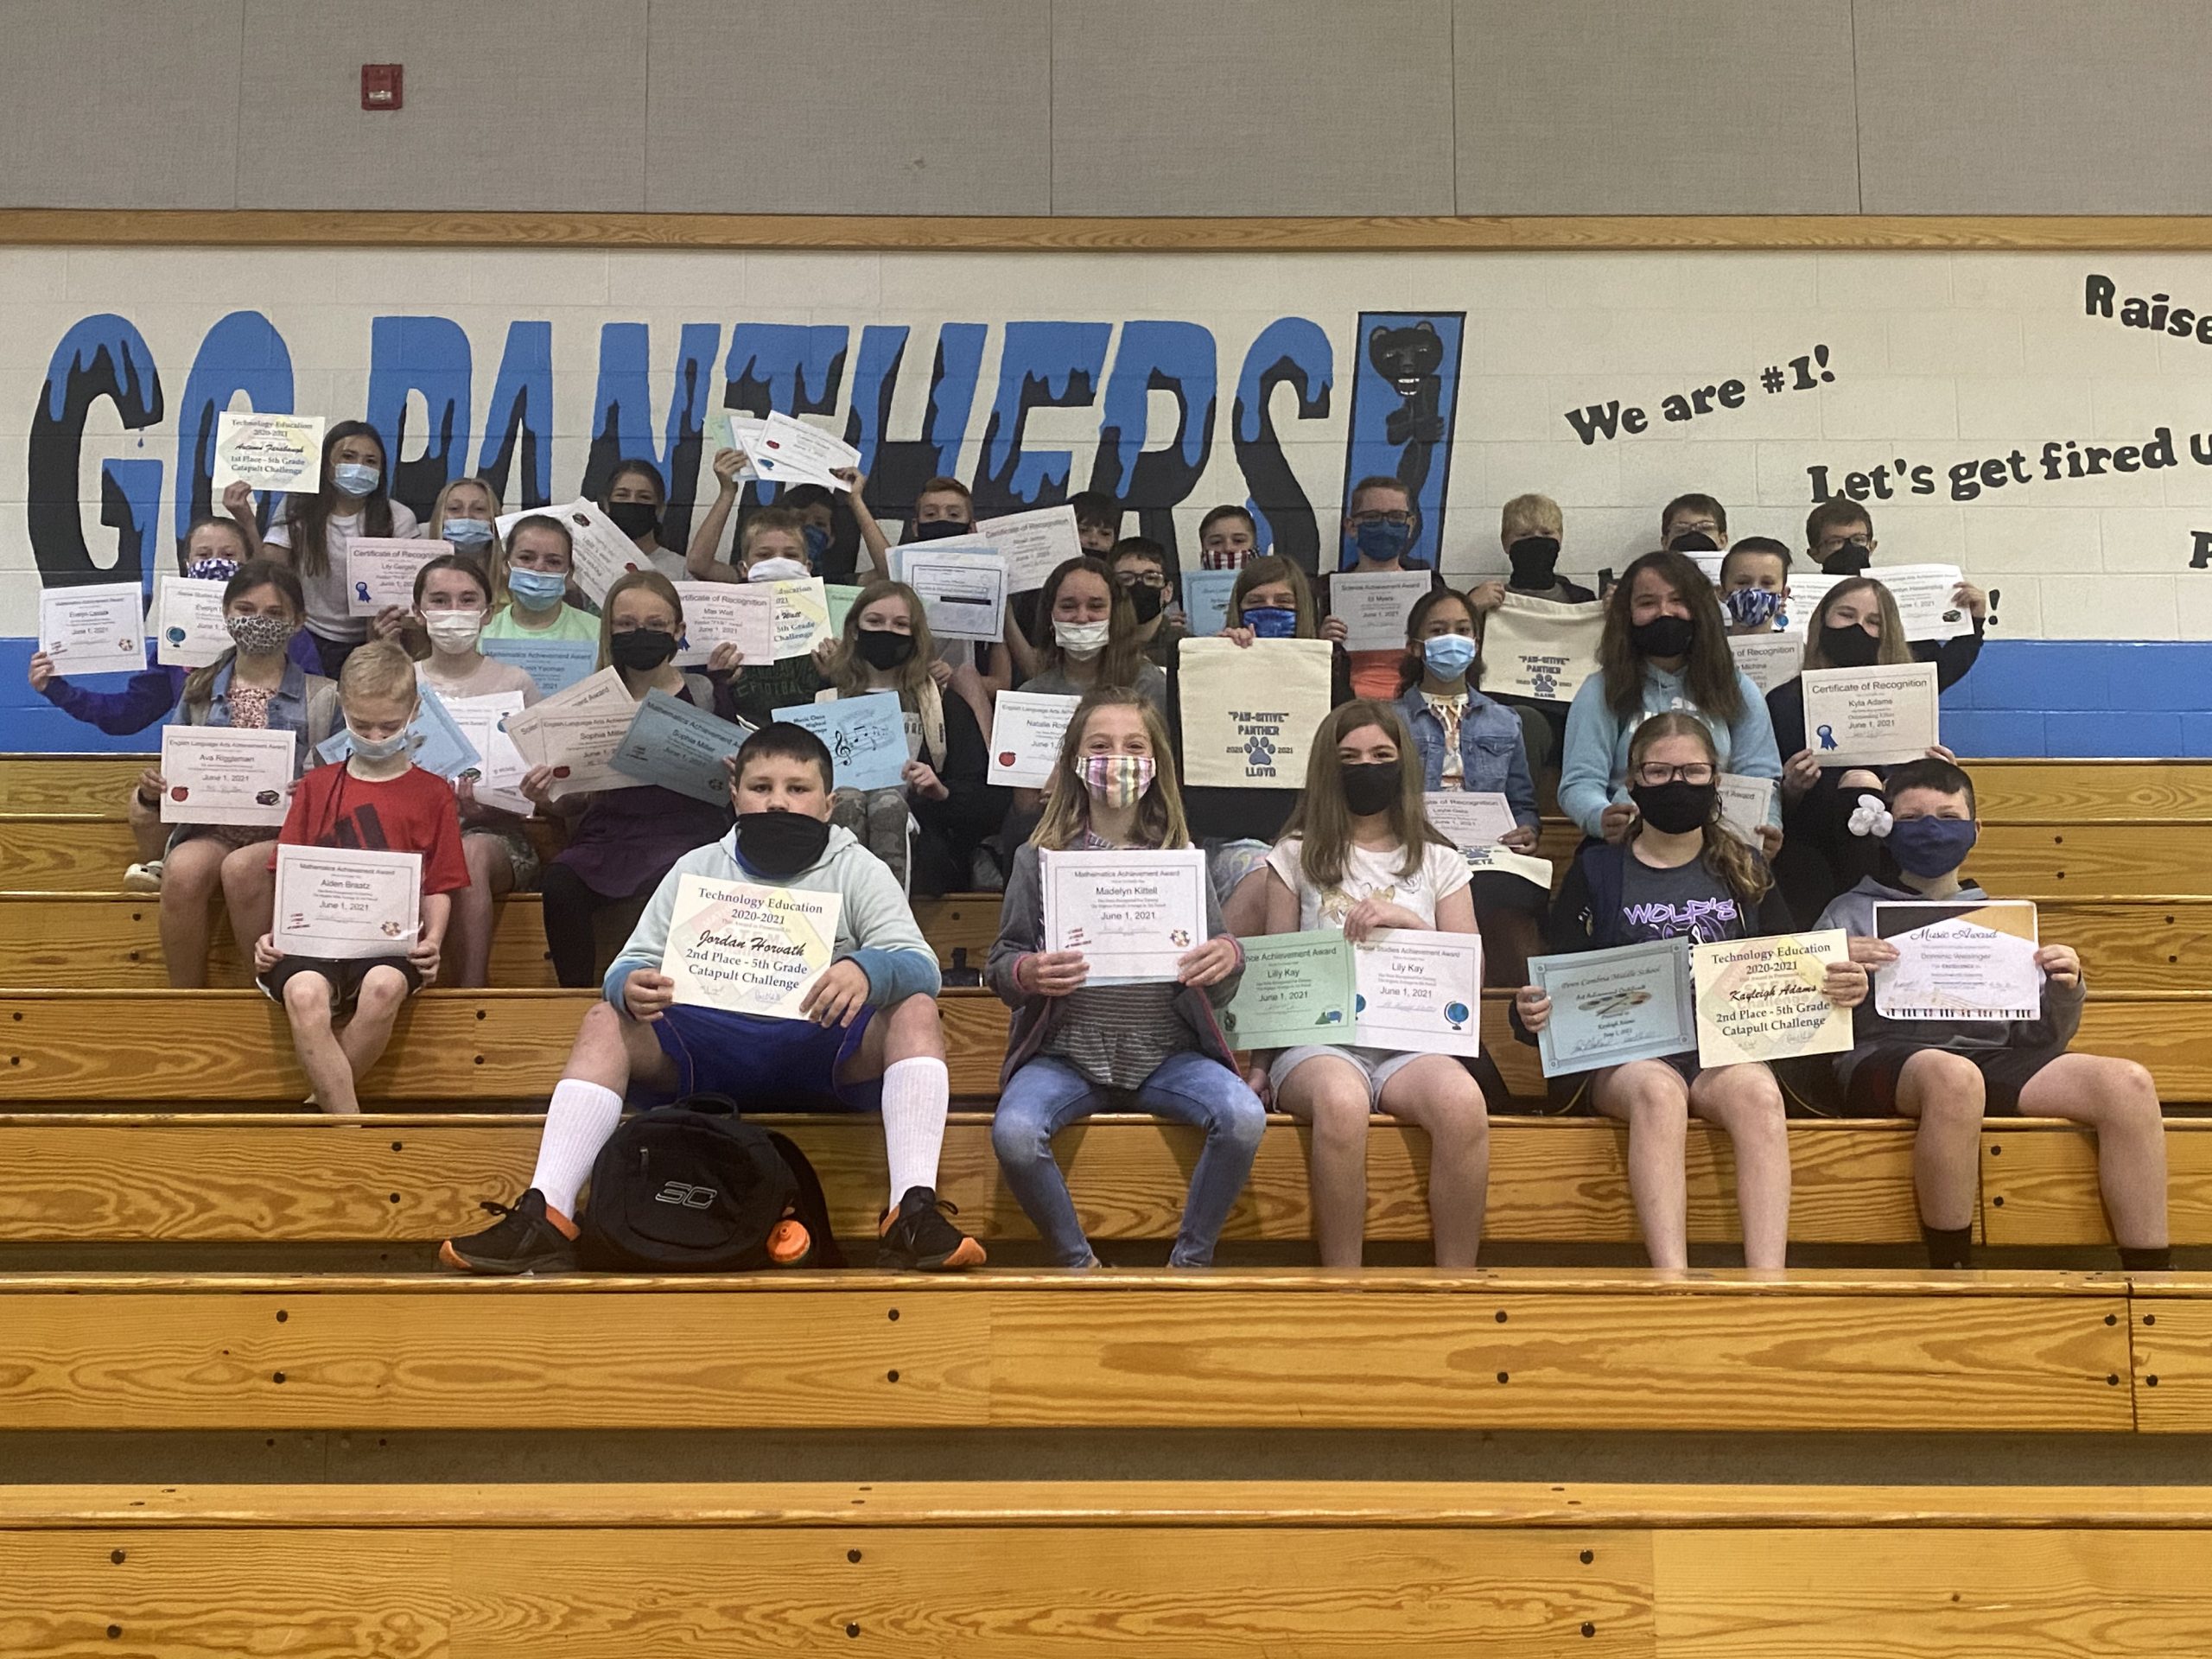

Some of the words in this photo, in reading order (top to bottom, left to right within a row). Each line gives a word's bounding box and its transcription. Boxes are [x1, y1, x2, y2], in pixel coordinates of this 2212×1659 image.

[2086, 274, 2212, 345] Raise
[1565, 400, 1648, 445] We
[1662, 379, 1745, 422] are
[1760, 344, 1835, 393] #1!
[28, 311, 294, 618] GO
[264, 466, 302, 475] Challenge
[1808, 458, 1935, 503] Let's
[1948, 449, 2031, 501] get
[2040, 427, 2177, 480] fired
[721, 595, 767, 607] Recognition
[774, 632, 813, 642] Challenge
[1747, 646, 1795, 656] Recognition
[1812, 684, 1858, 694] Certificate
[1872, 679, 1927, 690] Recognition
[647, 702, 689, 725] Mathematics
[690, 721, 732, 746] Achievement
[1238, 725, 1280, 735] PANTHER
[1246, 766, 1276, 777] LLOYD
[300, 863, 335, 872] Mathematics
[337, 866, 374, 874] Achievement
[321, 879, 343, 888] Aiden
[1096, 887, 1132, 896] Madelyn
[1135, 887, 1158, 895] Kittell
[319, 900, 339, 909] June
[349, 902, 369, 911] 2021
[698, 887, 765, 909] Technology
[767, 898, 823, 913] Education
[731, 908, 785, 925] 2020-2021
[1910, 927, 1949, 941] Music
[1952, 928, 1998, 939] Award
[696, 930, 746, 949] Jordan
[751, 937, 806, 957] Horvath
[1356, 944, 1375, 952] Social
[1376, 944, 1400, 954] Studies
[1402, 947, 1440, 957] Achievement
[1261, 950, 1311, 962] Achievement
[1313, 947, 1337, 957] Award
[1712, 949, 1774, 964] Technology
[1777, 944, 1831, 957] Education
[685, 949, 708, 961] 2nd
[711, 951, 741, 966] Place
[751, 957, 770, 969] 5th
[772, 961, 808, 975] Grade
[1391, 963, 1407, 974] Lily
[1408, 963, 1424, 975] Kay
[1746, 961, 1798, 975] 2020-2021
[689, 964, 738, 981] Catapult
[741, 971, 799, 991] Challenge
[1284, 969, 1300, 979] Kay
[1637, 966, 1661, 976] School
[1258, 993, 1278, 1002] June
[1289, 991, 1308, 1000] 2021
[1380, 987, 1401, 996] June
[1412, 988, 1433, 998] 2021
[1730, 988, 1776, 1002] Kayleigh
[1778, 983, 1817, 996] Adams
[1716, 1012, 1736, 1022] 2nd
[1739, 1009, 1767, 1020] Place
[1776, 1005, 1793, 1015] 5th
[1796, 1001, 1830, 1013] Grade
[1722, 1022, 1768, 1036] Catapult
[1770, 1016, 1826, 1030] Challenge
